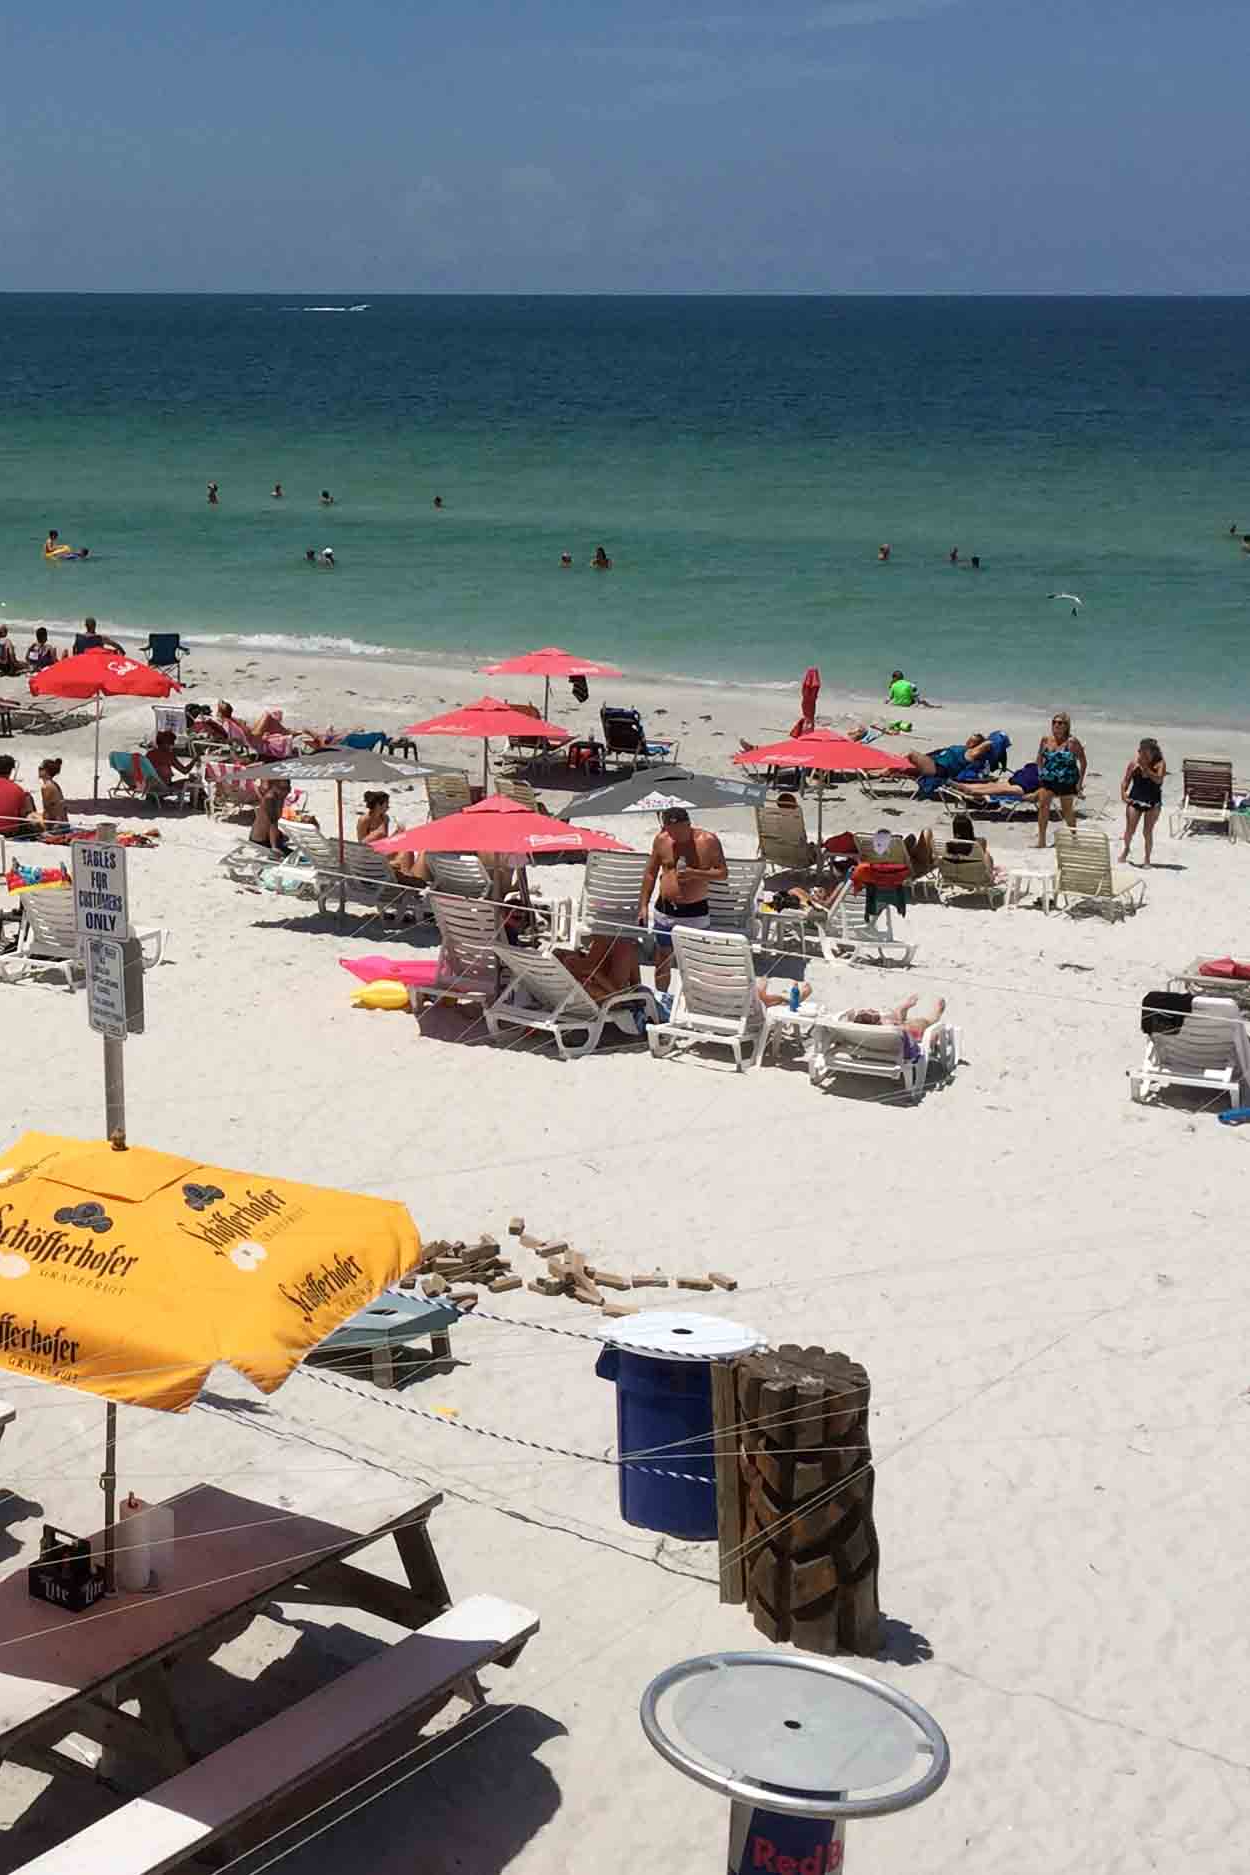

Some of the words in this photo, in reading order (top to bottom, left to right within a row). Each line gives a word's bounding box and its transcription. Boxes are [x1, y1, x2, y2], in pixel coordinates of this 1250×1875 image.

[81, 849, 116, 870] TABLES
[91, 872, 108, 891] FOR
[78, 890, 123, 913] CUSTOMERS
[85, 912, 117, 932] ONLY
[176, 1188, 286, 1257] Schöfferhofer
[278, 1253, 363, 1323] Schöfferhofer
[751, 1836, 823, 1875] Red
